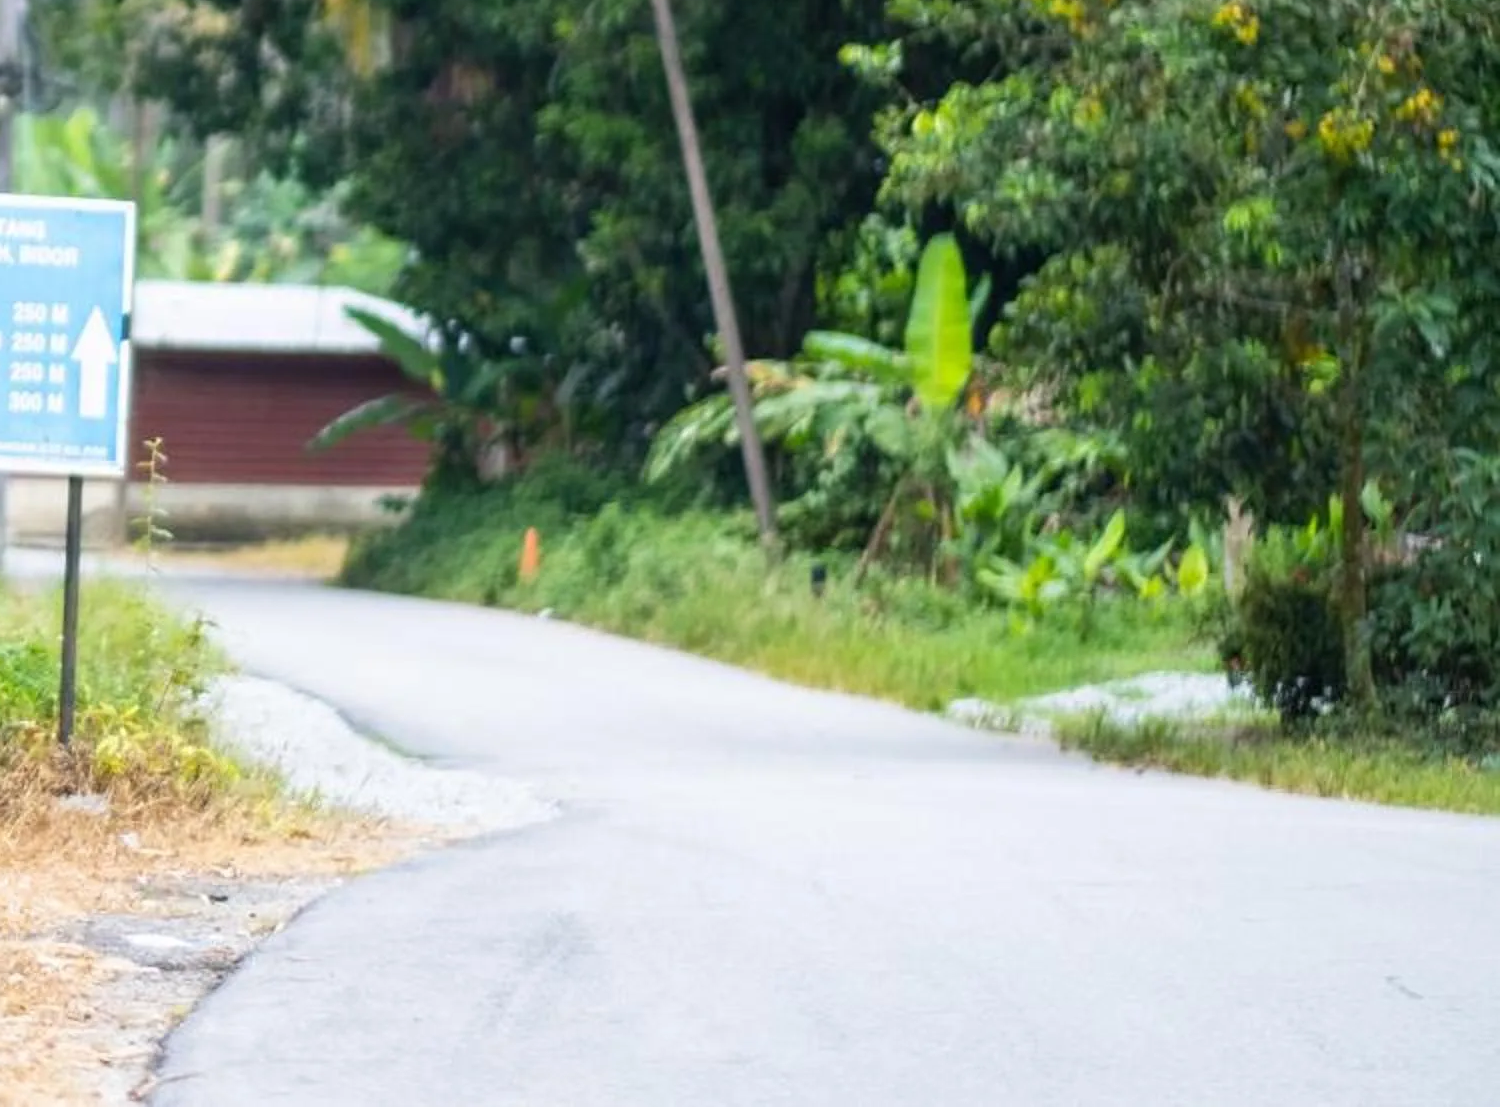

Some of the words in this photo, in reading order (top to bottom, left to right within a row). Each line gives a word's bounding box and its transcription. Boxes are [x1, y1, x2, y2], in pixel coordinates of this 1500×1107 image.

[13, 300, 47, 324] 250
[51, 302, 69, 326] M
[11, 332, 46, 354] 250
[50, 333, 69, 356] M
[9, 362, 44, 383] 250
[48, 363, 67, 385] M
[46, 392, 65, 414] M
